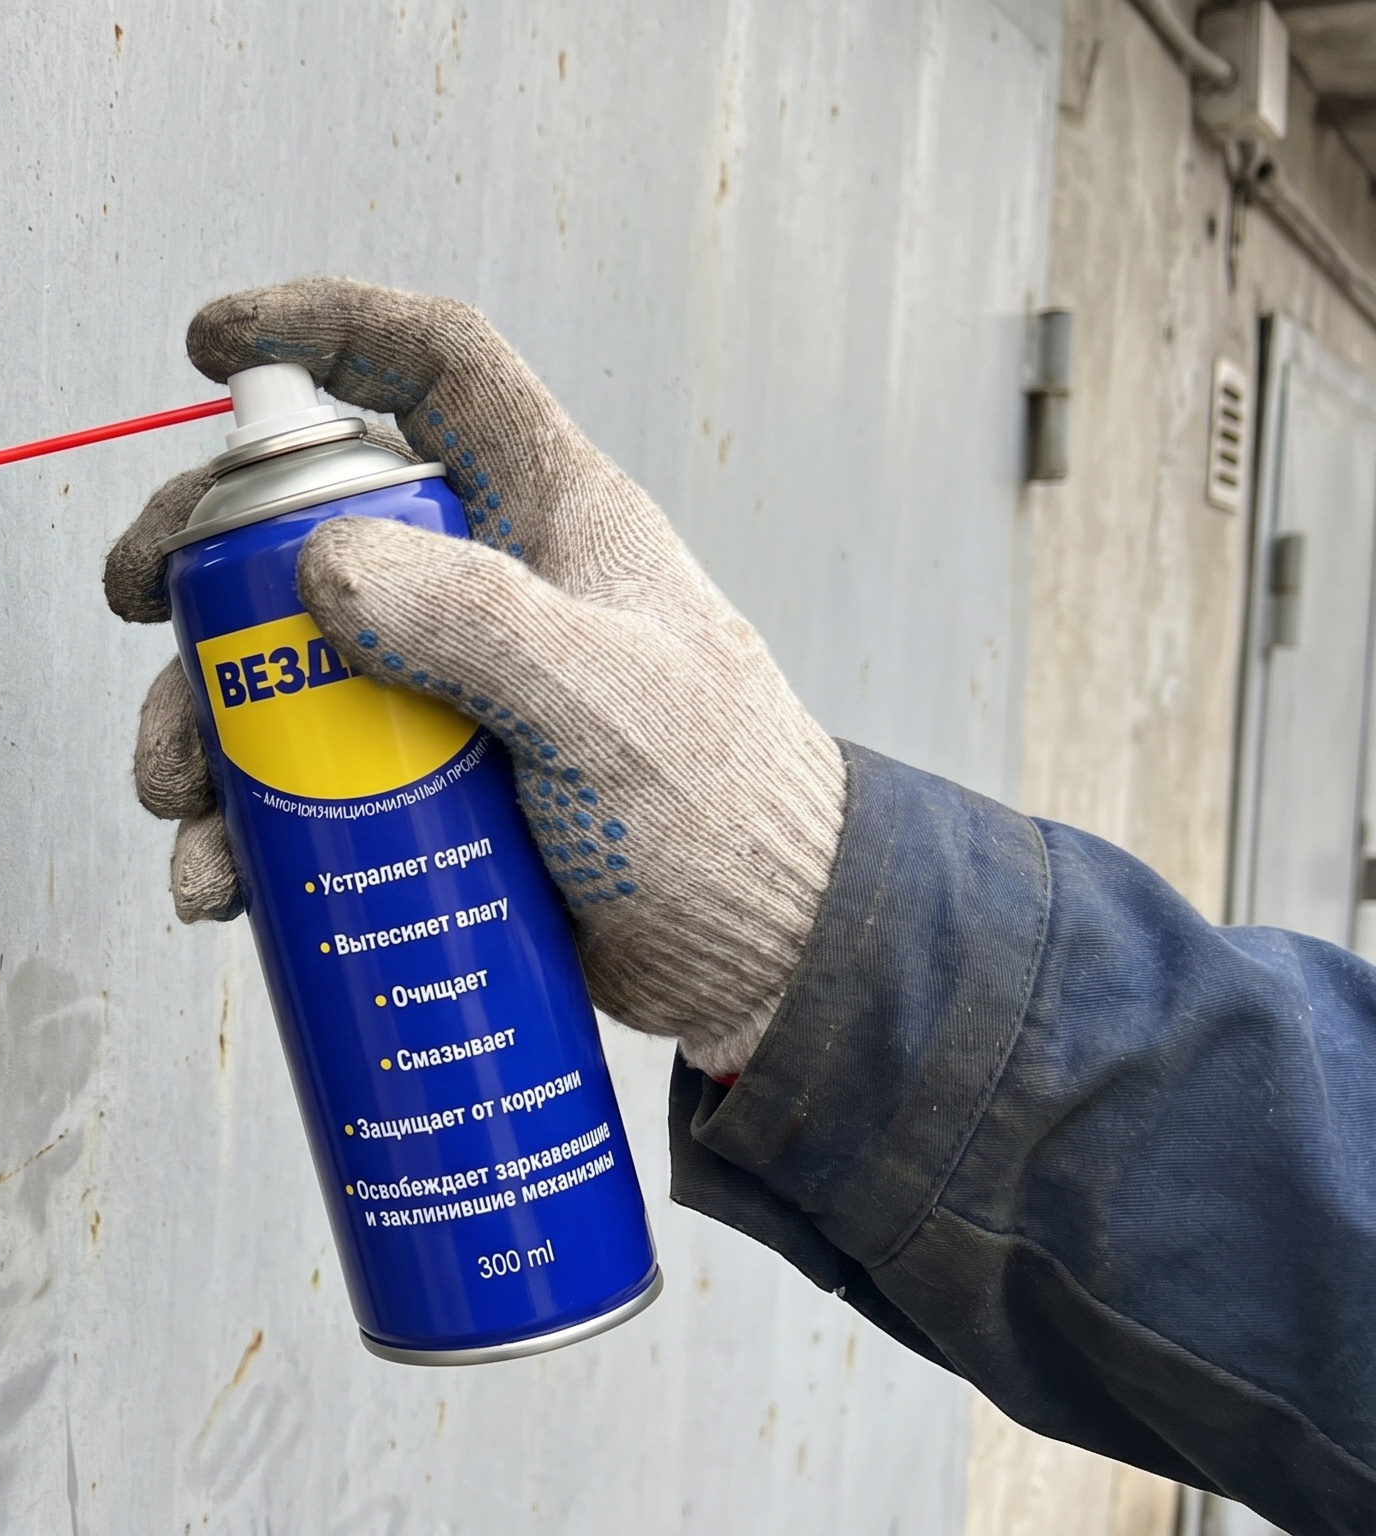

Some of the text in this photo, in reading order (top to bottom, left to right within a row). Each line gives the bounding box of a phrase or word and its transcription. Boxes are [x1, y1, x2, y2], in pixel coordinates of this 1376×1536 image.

[215, 636, 363, 709] ВЕЗД
[391, 969, 488, 1008] Очищает
[396, 1028, 515, 1071] Смазывает
[357, 1069, 582, 1140] Защищает от коррозии
[357, 1168, 489, 1201] Освобеждает
[365, 1151, 615, 1228] и заклинившие механизмы
[477, 1239, 555, 1279] 300 ml
